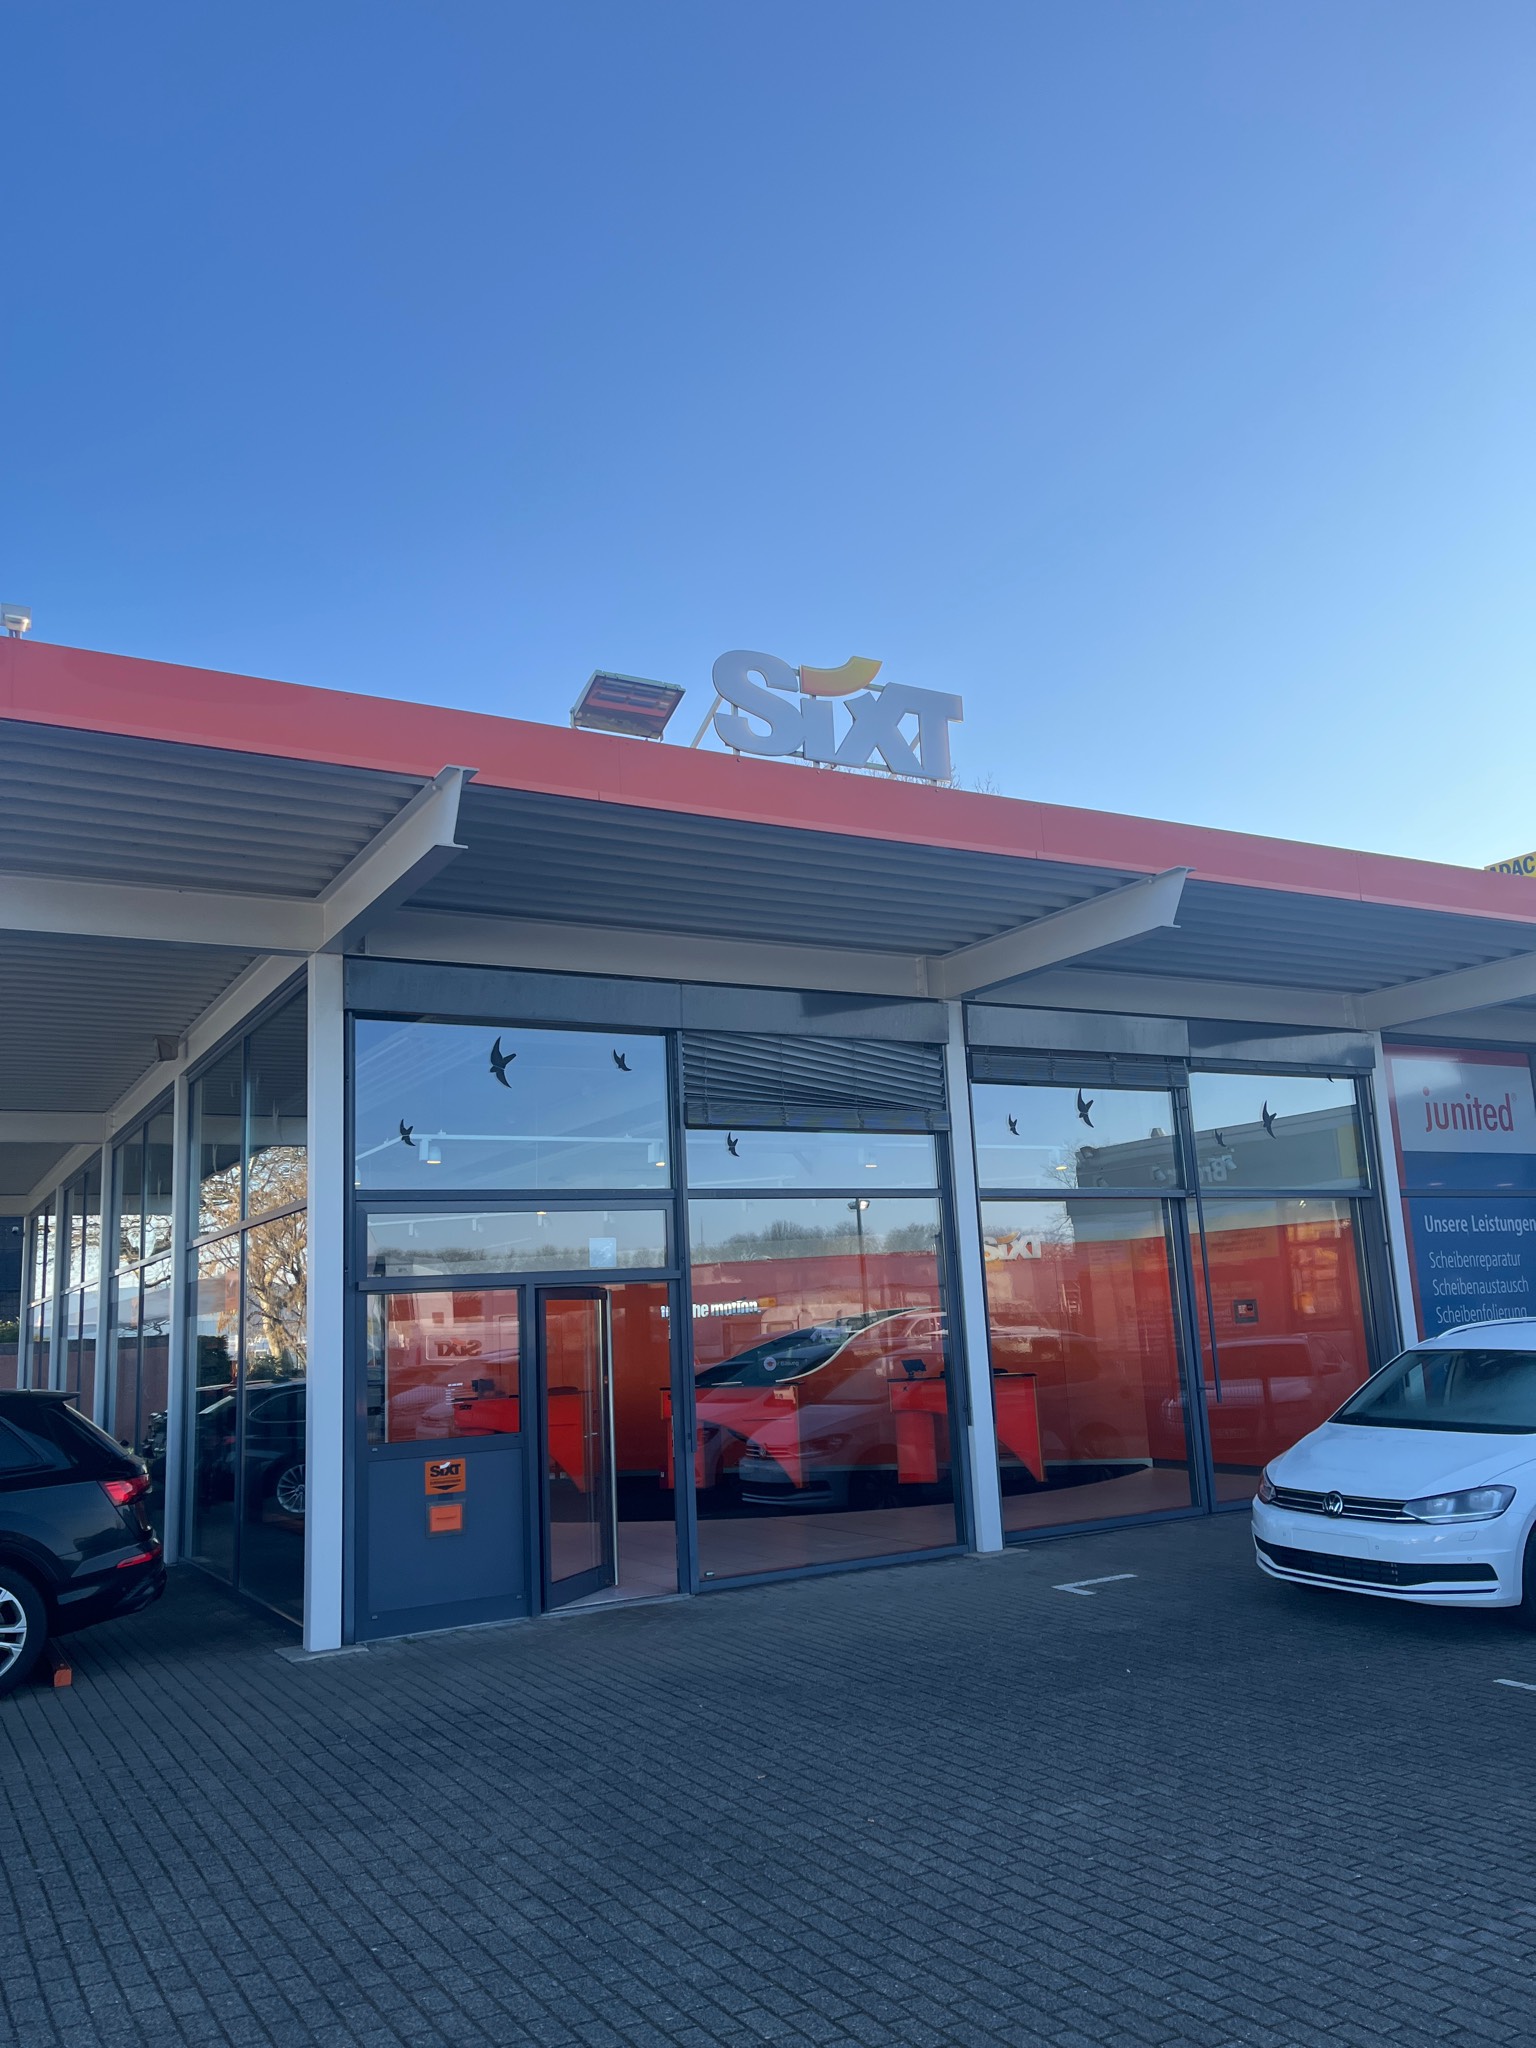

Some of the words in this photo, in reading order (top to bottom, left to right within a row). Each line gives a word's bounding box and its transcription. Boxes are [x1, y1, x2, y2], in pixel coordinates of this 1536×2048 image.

[1423, 1086, 1514, 1132] junited
[1424, 1215, 1468, 1233] Unsere
[1471, 1214, 1536, 1236] Leistungen
[1428, 1250, 1521, 1271] Scheibenreparatur
[1432, 1275, 1530, 1296] Scheibenaustausch
